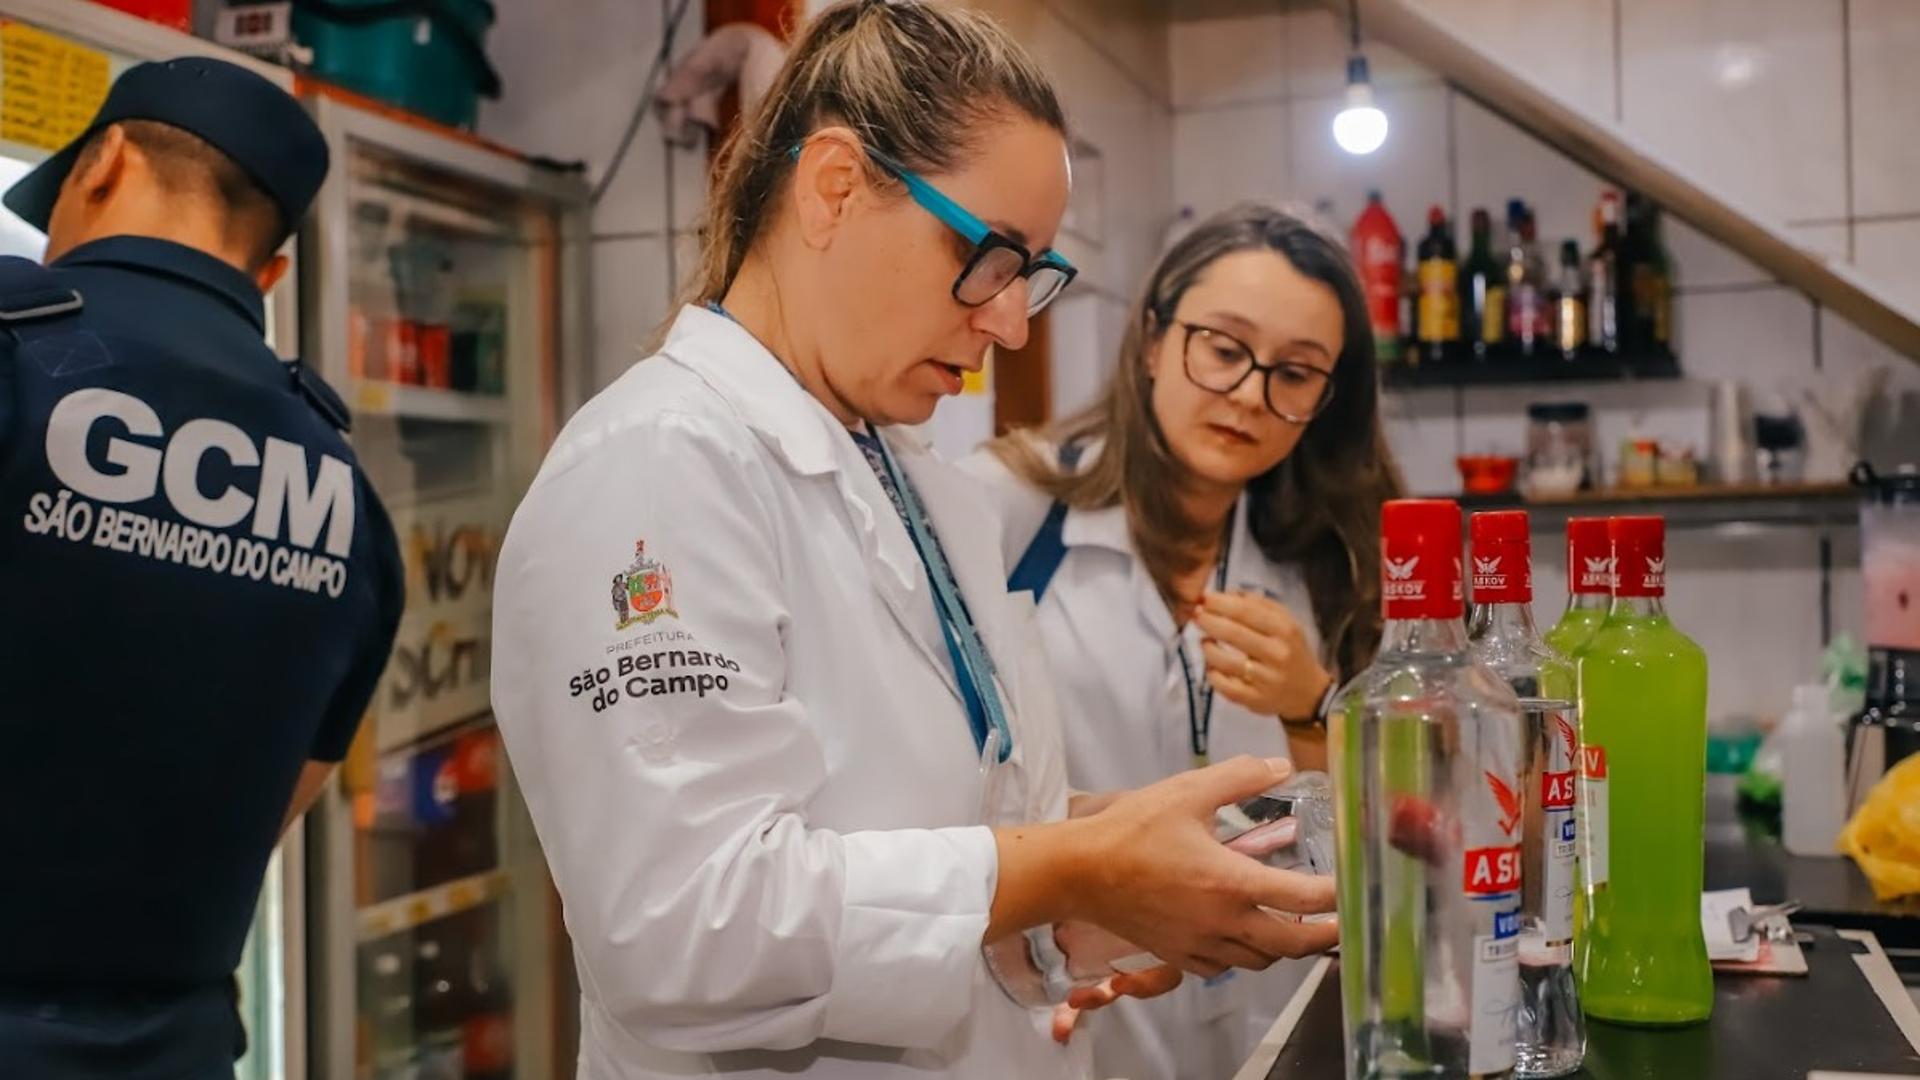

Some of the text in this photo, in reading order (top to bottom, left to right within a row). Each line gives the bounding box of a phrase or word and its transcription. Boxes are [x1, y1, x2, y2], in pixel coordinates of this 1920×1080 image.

[46, 388, 355, 559] GCM
[24, 490, 347, 598] SÃO BERNARDO DO CAMPO
[606, 631, 695, 654] PREFEITURA
[569, 650, 740, 697] São Bernardo
[592, 673, 728, 712] do Campo
